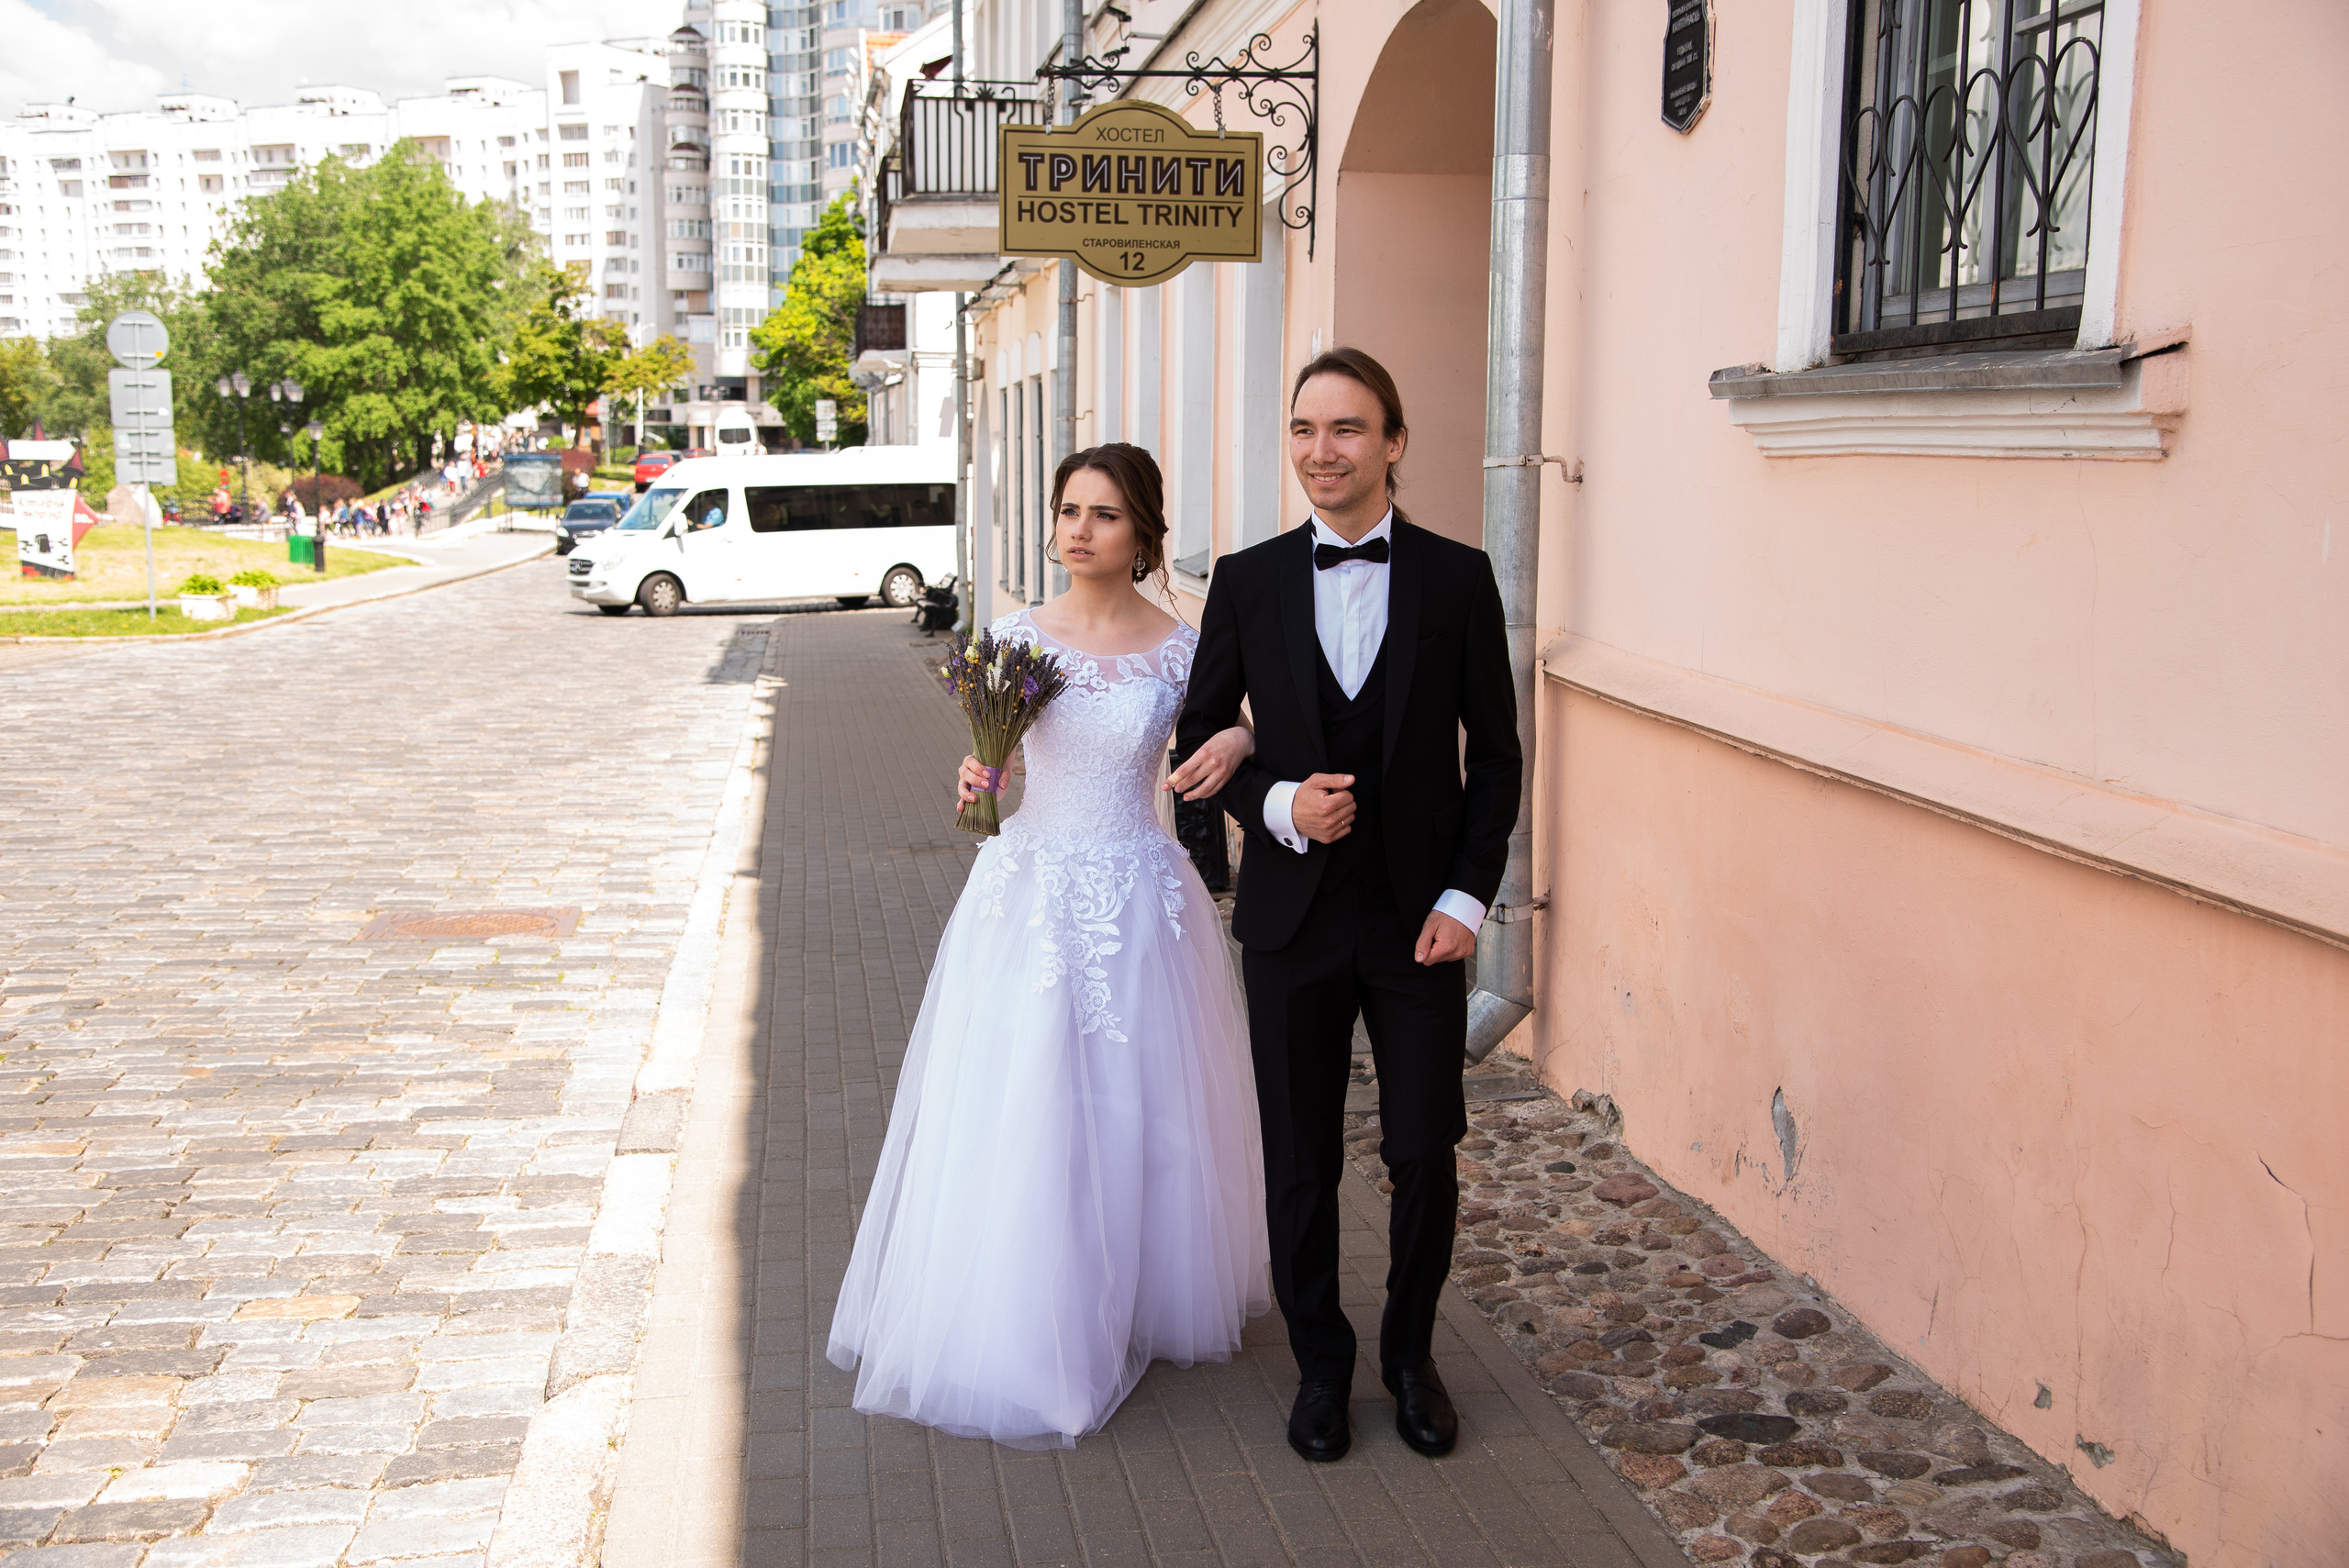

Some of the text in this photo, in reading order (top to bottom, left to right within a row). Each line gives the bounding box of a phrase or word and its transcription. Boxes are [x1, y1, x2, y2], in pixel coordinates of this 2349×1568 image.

[1096, 127, 1164, 143] ХОСТЕЛ
[1018, 152, 1245, 197] ТРИНИТИ
[1018, 200, 1243, 228] HOSTEL TRINITY
[1083, 238, 1181, 250] СТАРОВИЛЕНСКАЯ
[1119, 251, 1145, 271] 12
